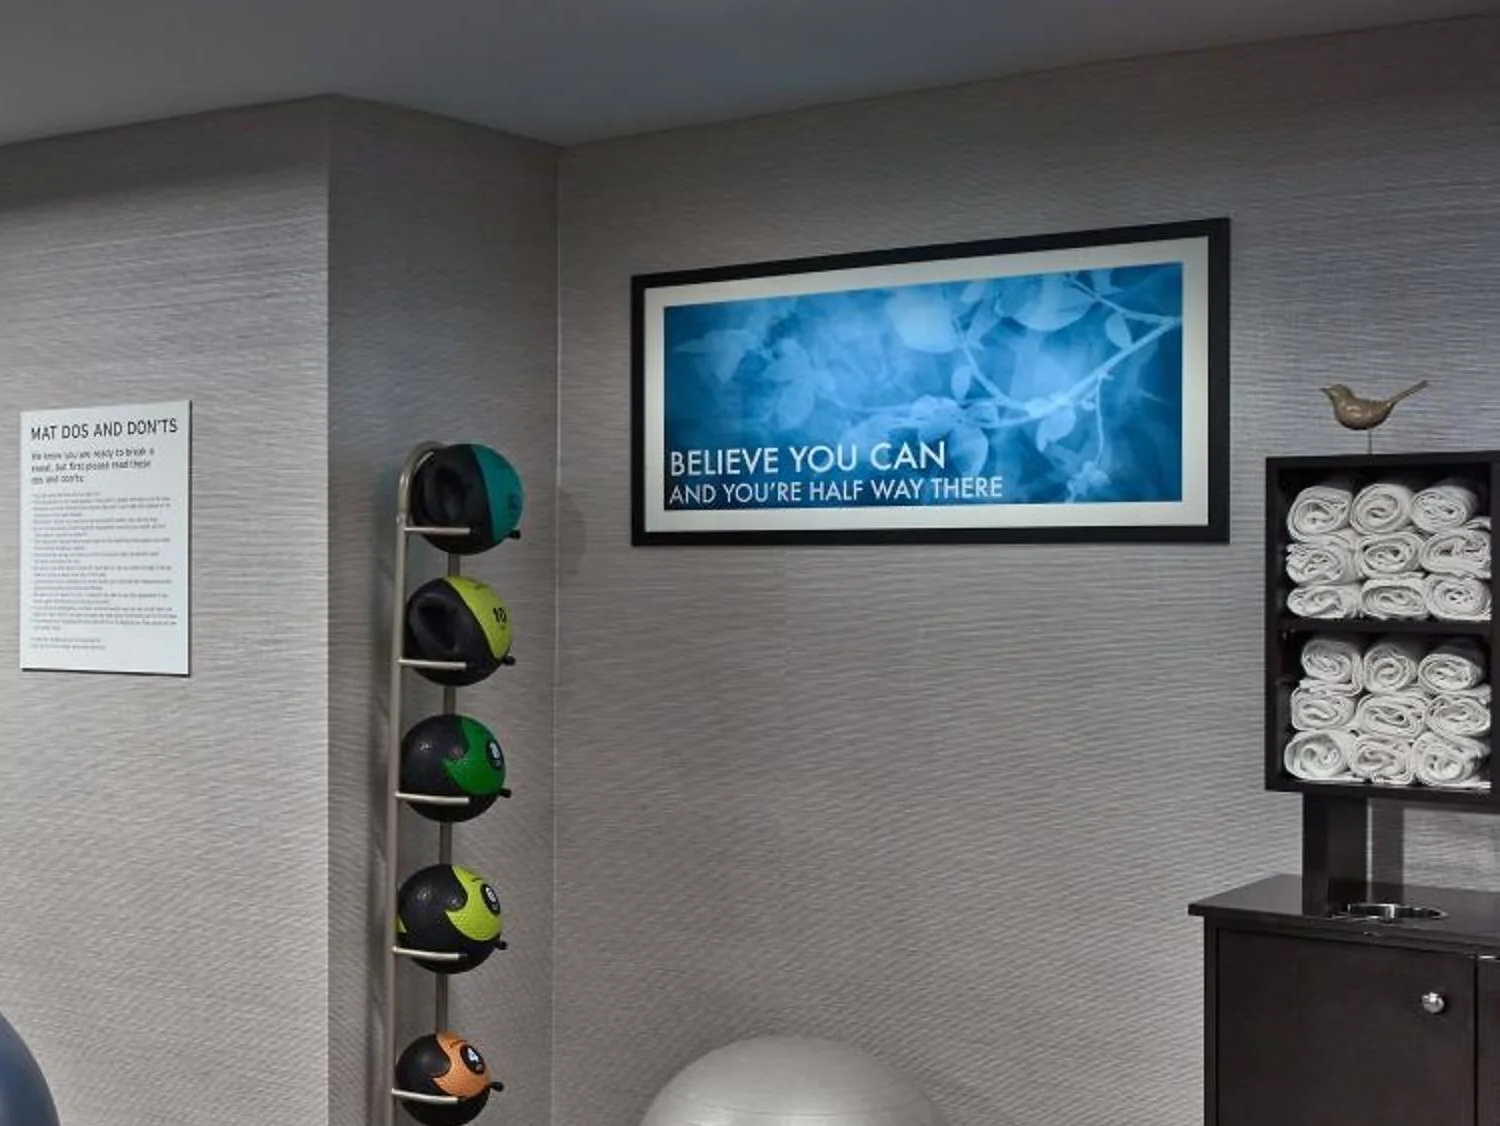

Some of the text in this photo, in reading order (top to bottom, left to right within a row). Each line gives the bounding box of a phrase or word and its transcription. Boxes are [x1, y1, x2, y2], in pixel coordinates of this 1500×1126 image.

[31, 417, 179, 441] MAT DOS AND DON'TS
[670, 440, 946, 477] BELIEVE YOU CAN
[669, 475, 1003, 505] AND YOU'RE HALF WAY THERE
